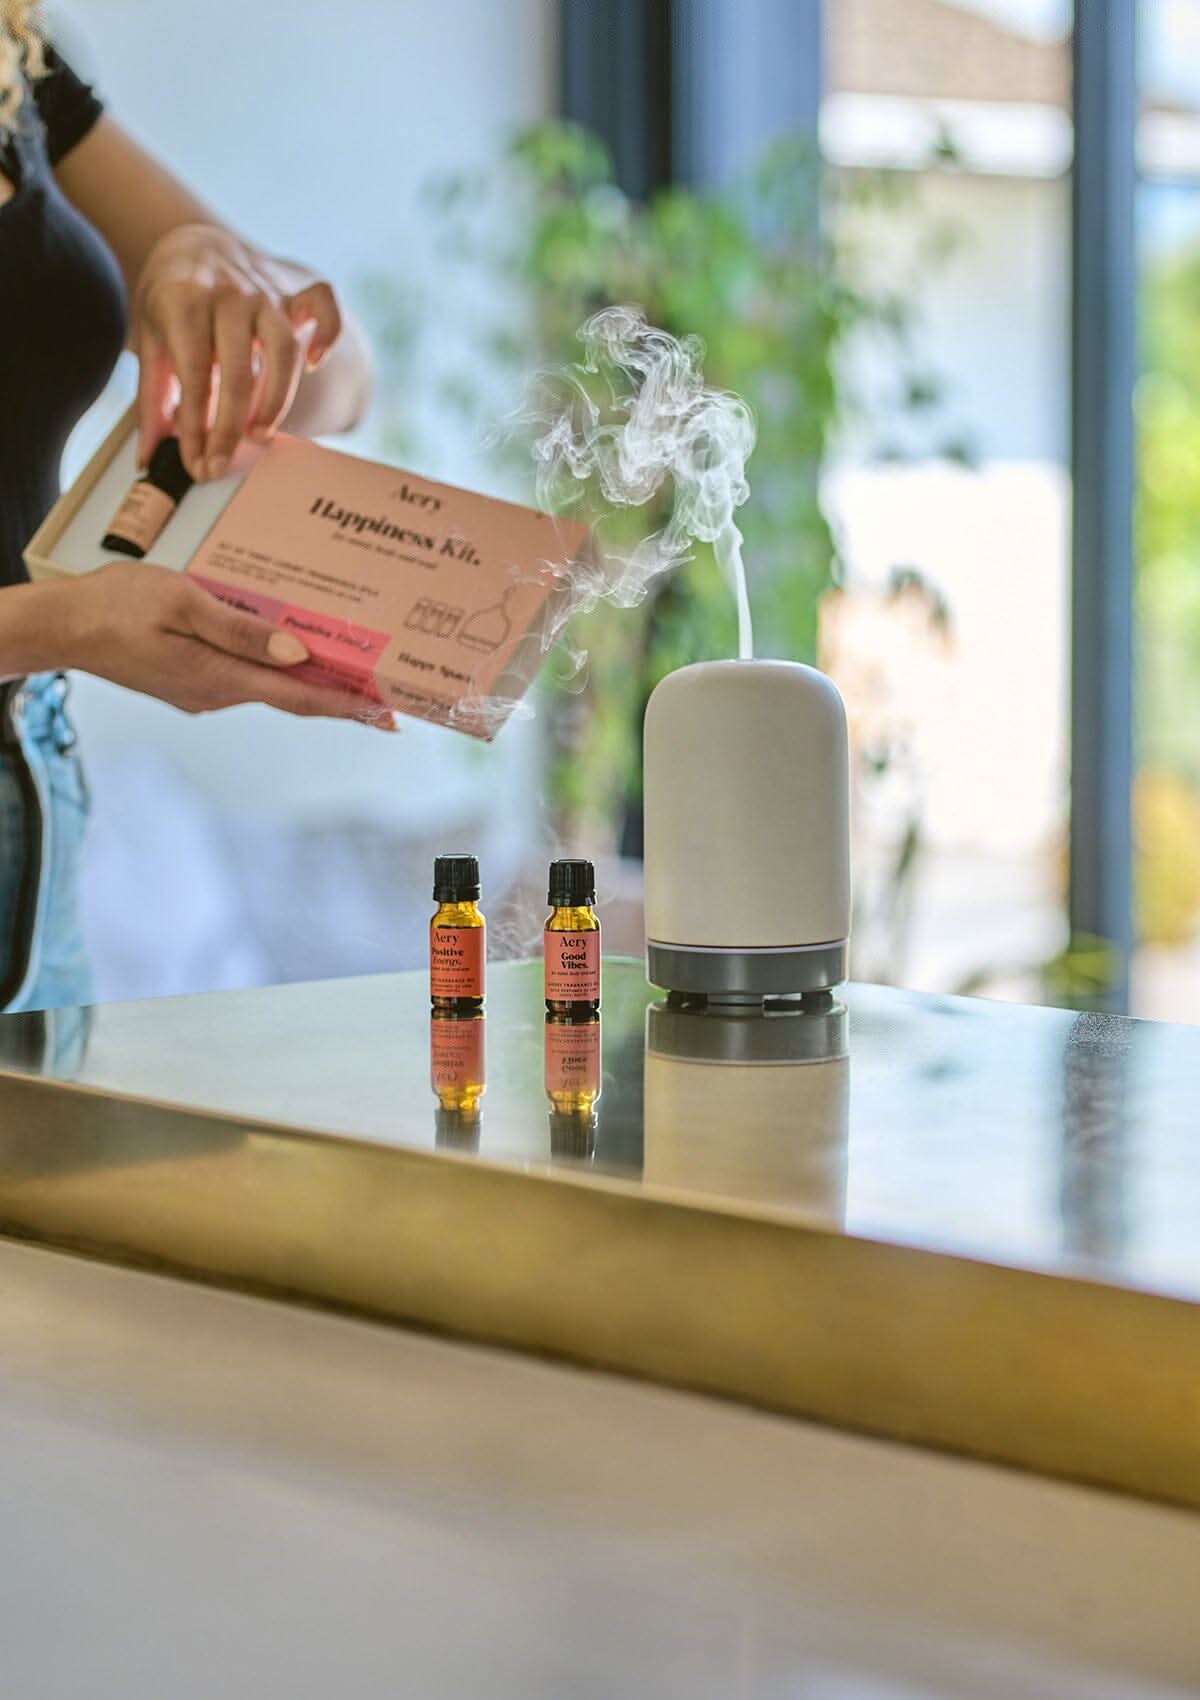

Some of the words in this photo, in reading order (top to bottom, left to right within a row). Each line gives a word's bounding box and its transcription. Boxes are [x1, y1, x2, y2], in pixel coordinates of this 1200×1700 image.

[309, 497, 435, 550] Happiness
[434, 931, 460, 945] Aery
[560, 936, 587, 949] Aery
[561, 952, 587, 961] Good
